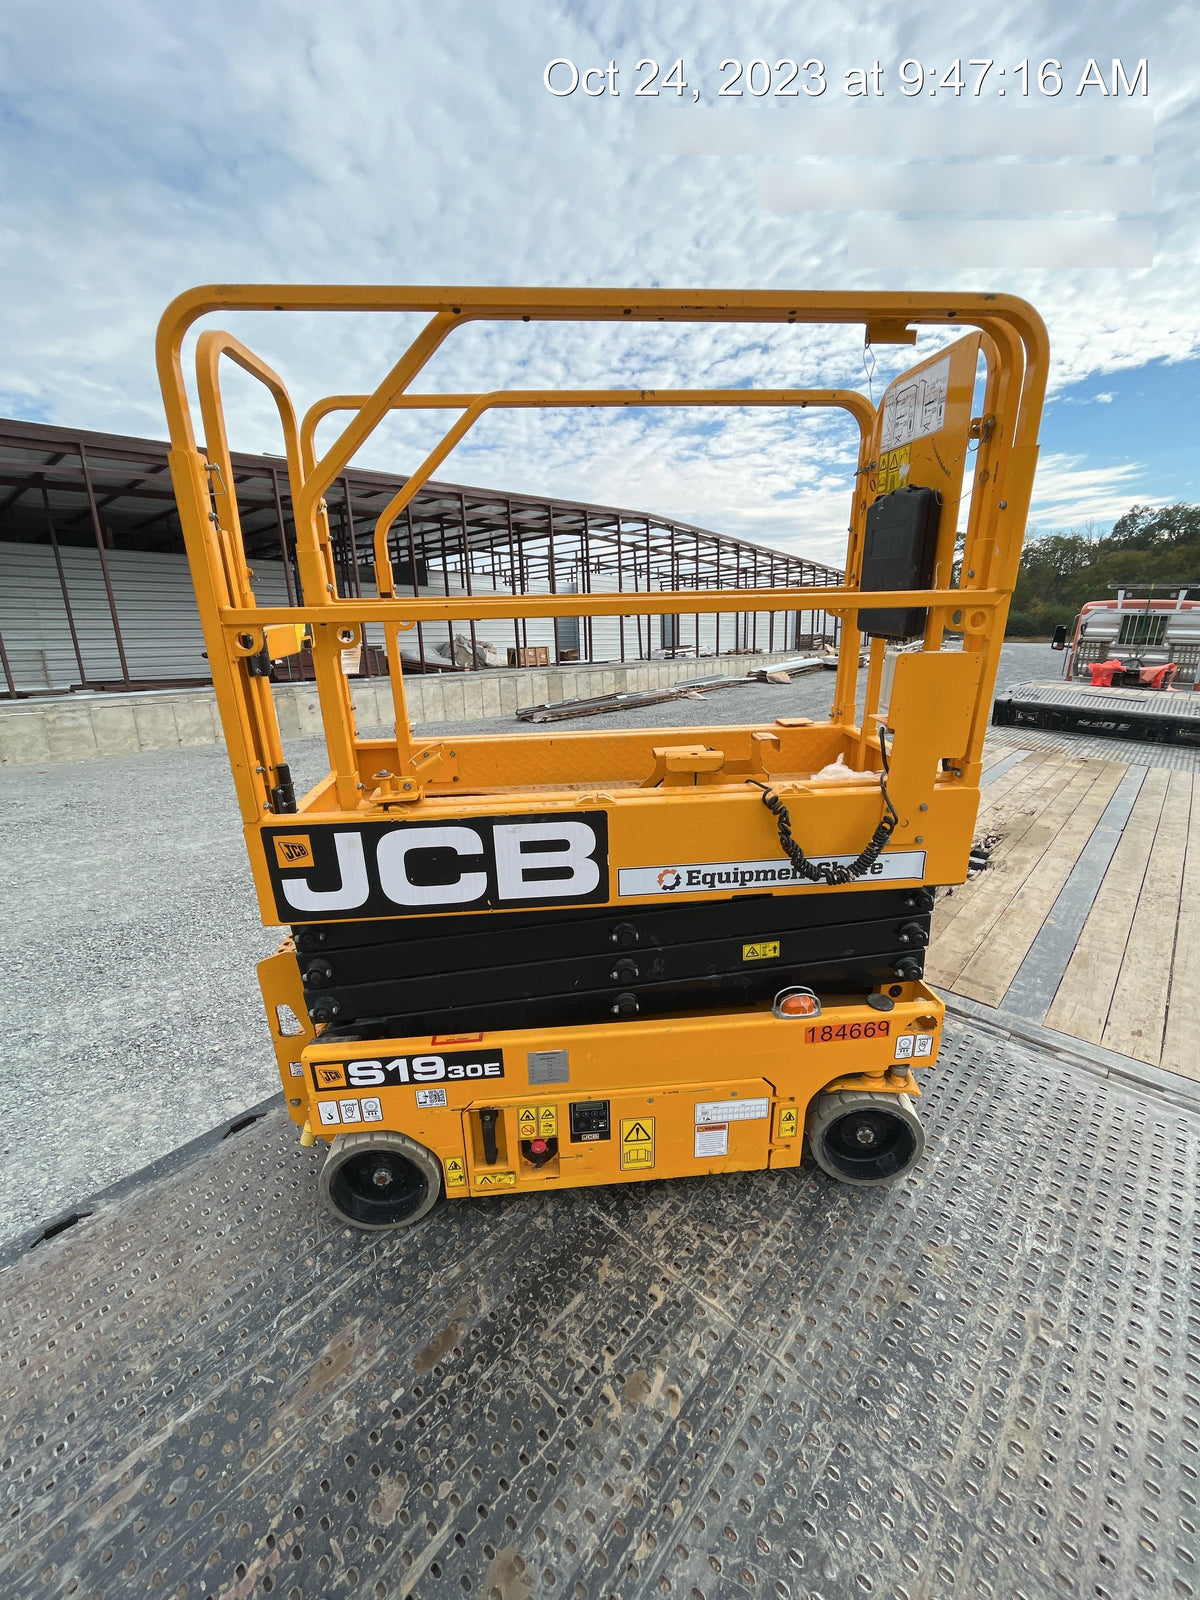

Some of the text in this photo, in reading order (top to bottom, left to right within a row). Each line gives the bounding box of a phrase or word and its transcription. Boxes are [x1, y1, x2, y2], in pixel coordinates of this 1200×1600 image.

[284, 843, 307, 860] JCB
[281, 821, 600, 912] JCB
[807, 1020, 890, 1043] 184669
[323, 1069, 341, 1081] JCB
